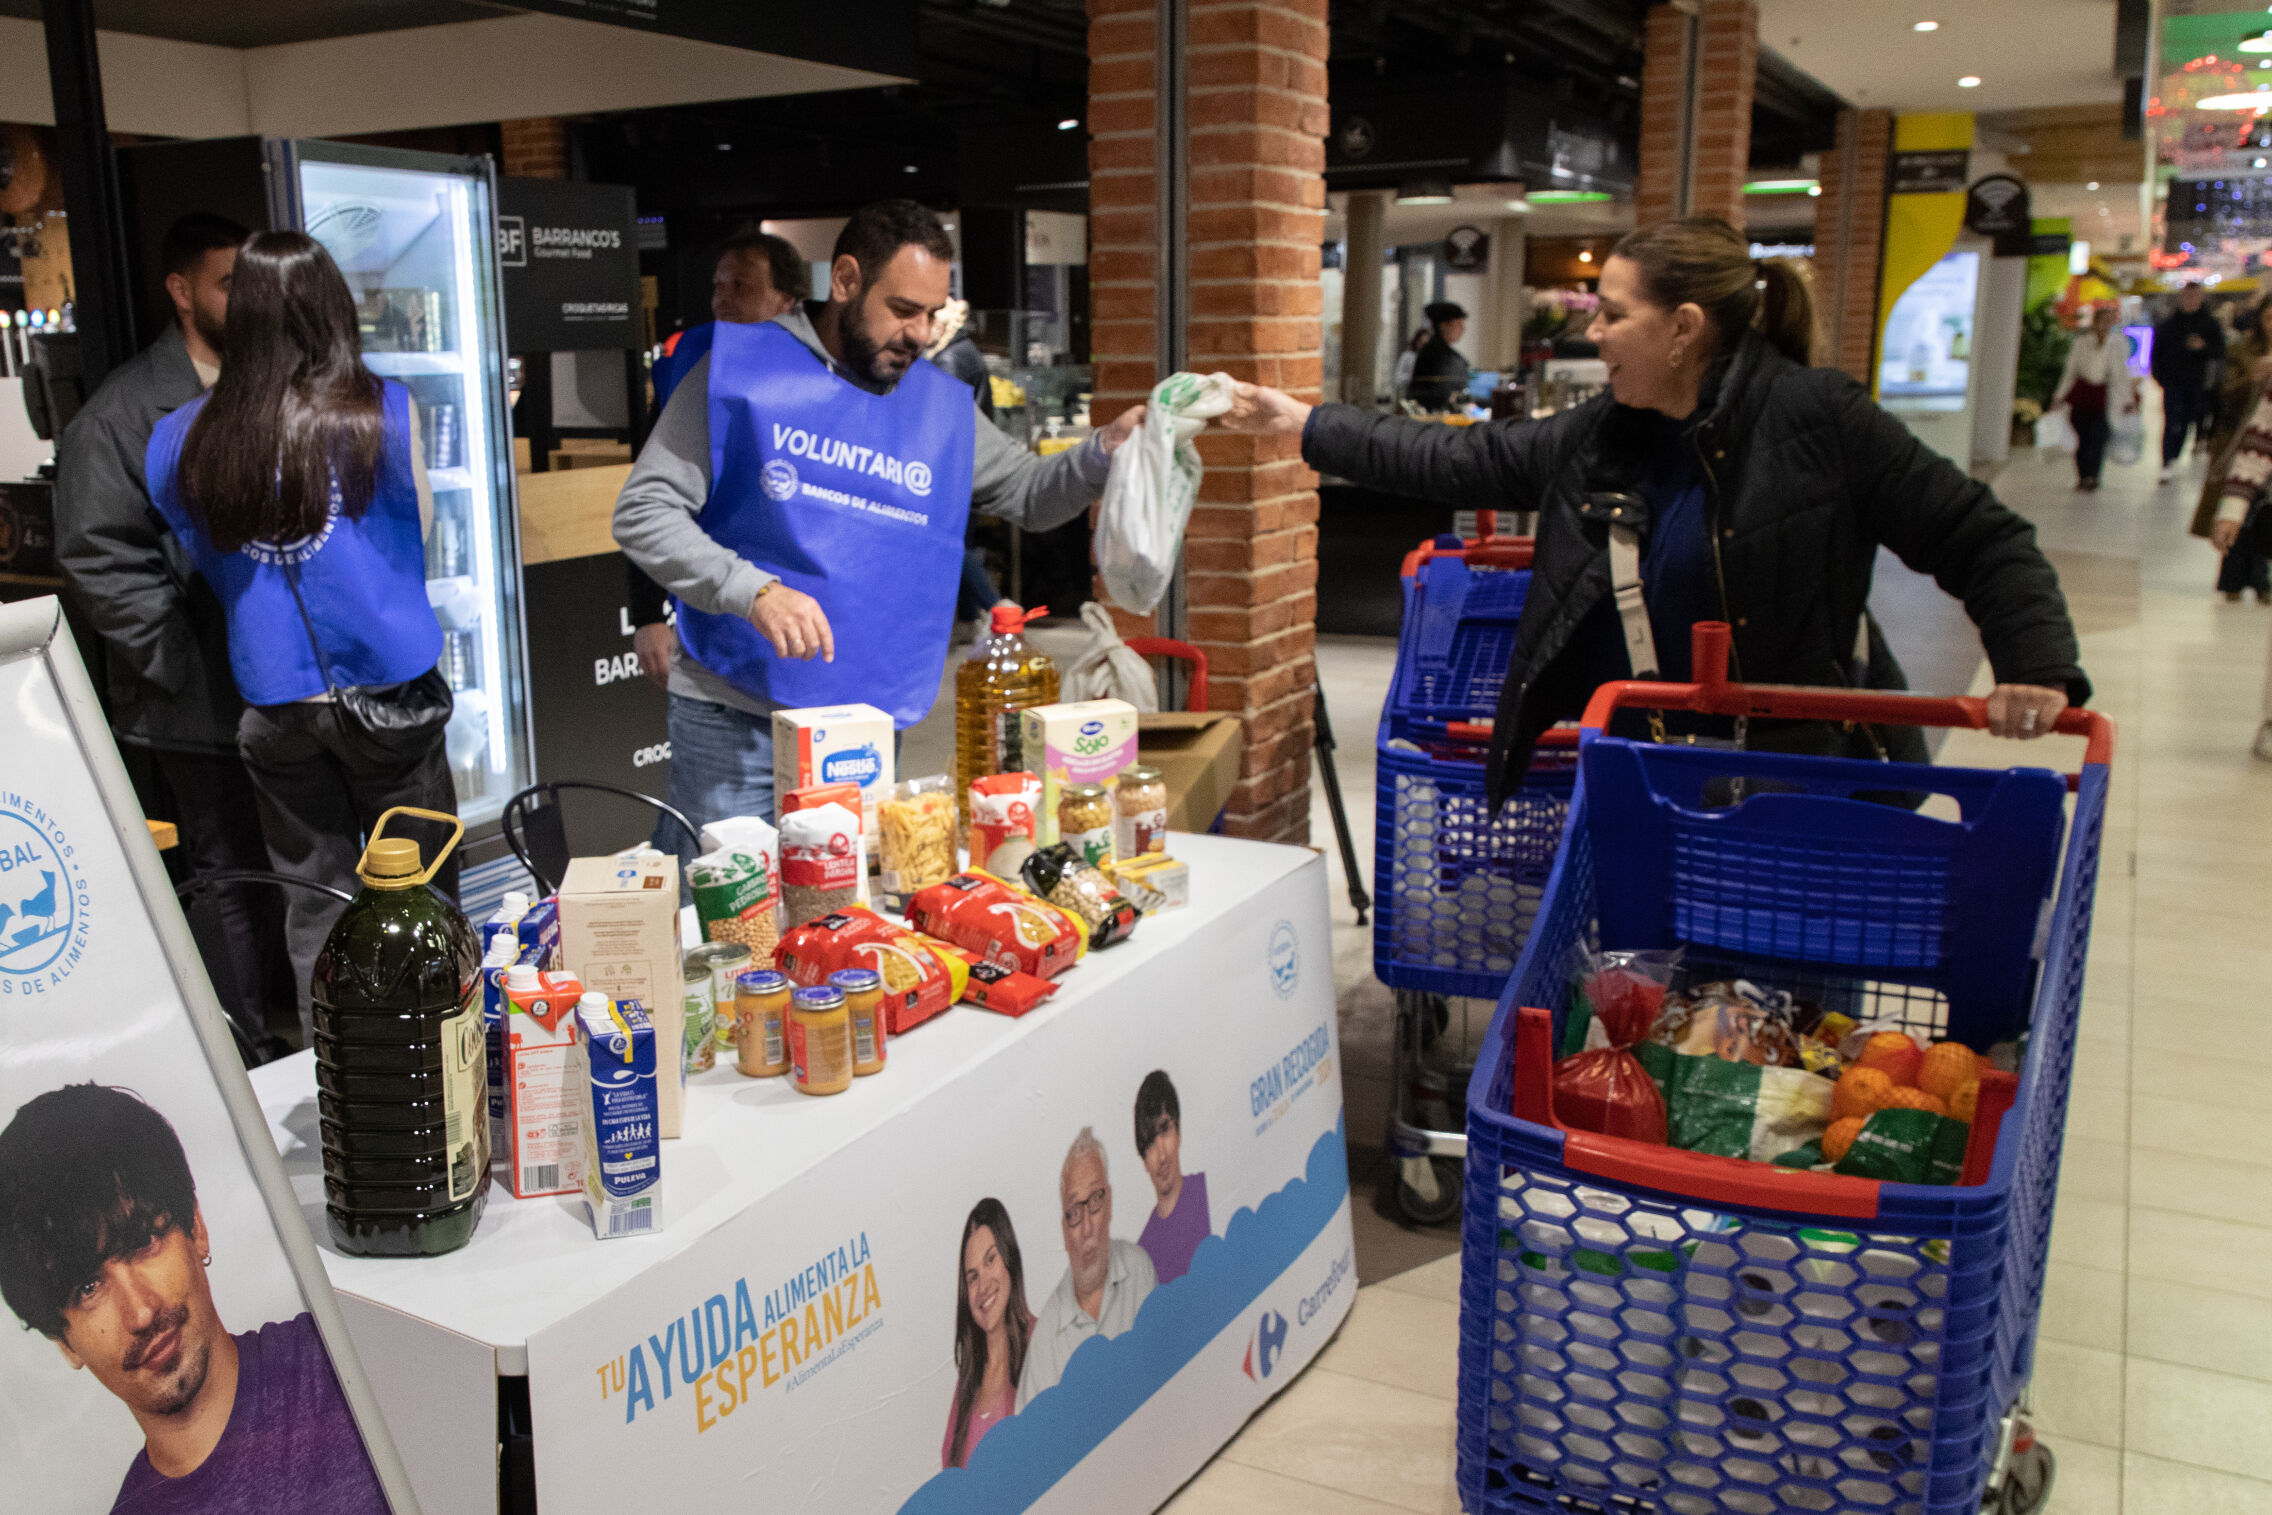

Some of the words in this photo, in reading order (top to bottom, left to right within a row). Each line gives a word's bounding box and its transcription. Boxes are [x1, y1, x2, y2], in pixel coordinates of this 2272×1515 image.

[532, 226, 620, 248] BARRANCO'S
[773, 422, 933, 497] VOLUNTARI@
[801, 482, 851, 506] BANCOS
[850, 495, 868, 511] DE
[866, 501, 929, 527] ALIMENTOS
[0, 791, 74, 859] IMENTOS
[21, 978, 46, 996] DE
[50, 878, 91, 987] ALIMENTOS
[1250, 1062, 1284, 1118] GRAN
[1281, 1020, 1331, 1092] RECOGIDA
[596, 1354, 626, 1401] TU
[625, 1276, 759, 1425] AYUDA
[764, 1245, 850, 1329] ALIMENTA
[850, 1231, 872, 1269] LA
[694, 1262, 882, 1435] ESPERANZA
[785, 1317, 885, 1394] #AlimentaLaEsperanza
